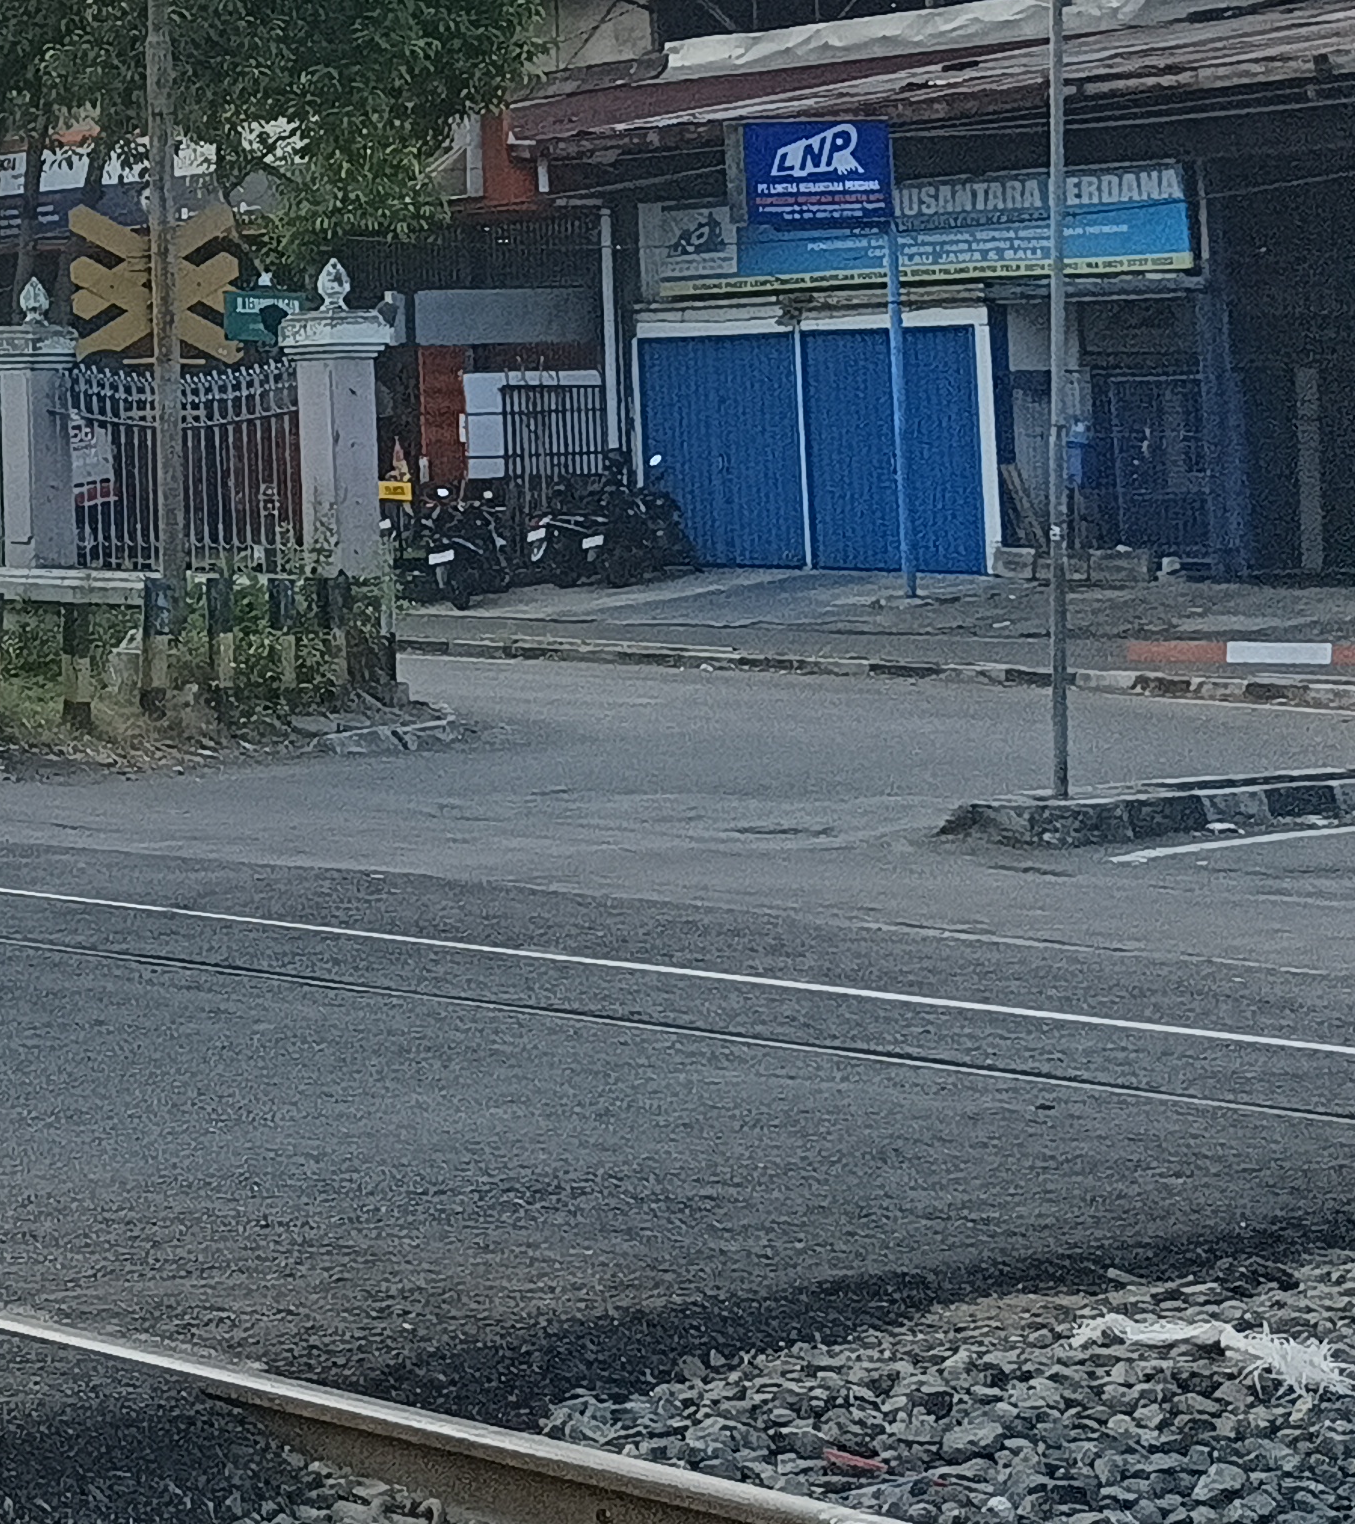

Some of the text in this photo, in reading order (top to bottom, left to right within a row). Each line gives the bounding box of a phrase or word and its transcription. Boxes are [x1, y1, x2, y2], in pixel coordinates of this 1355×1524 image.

[772, 125, 860, 177] LNP
[1049, 168, 1180, 207] ERDANA
[937, 251, 982, 264] JAWA
